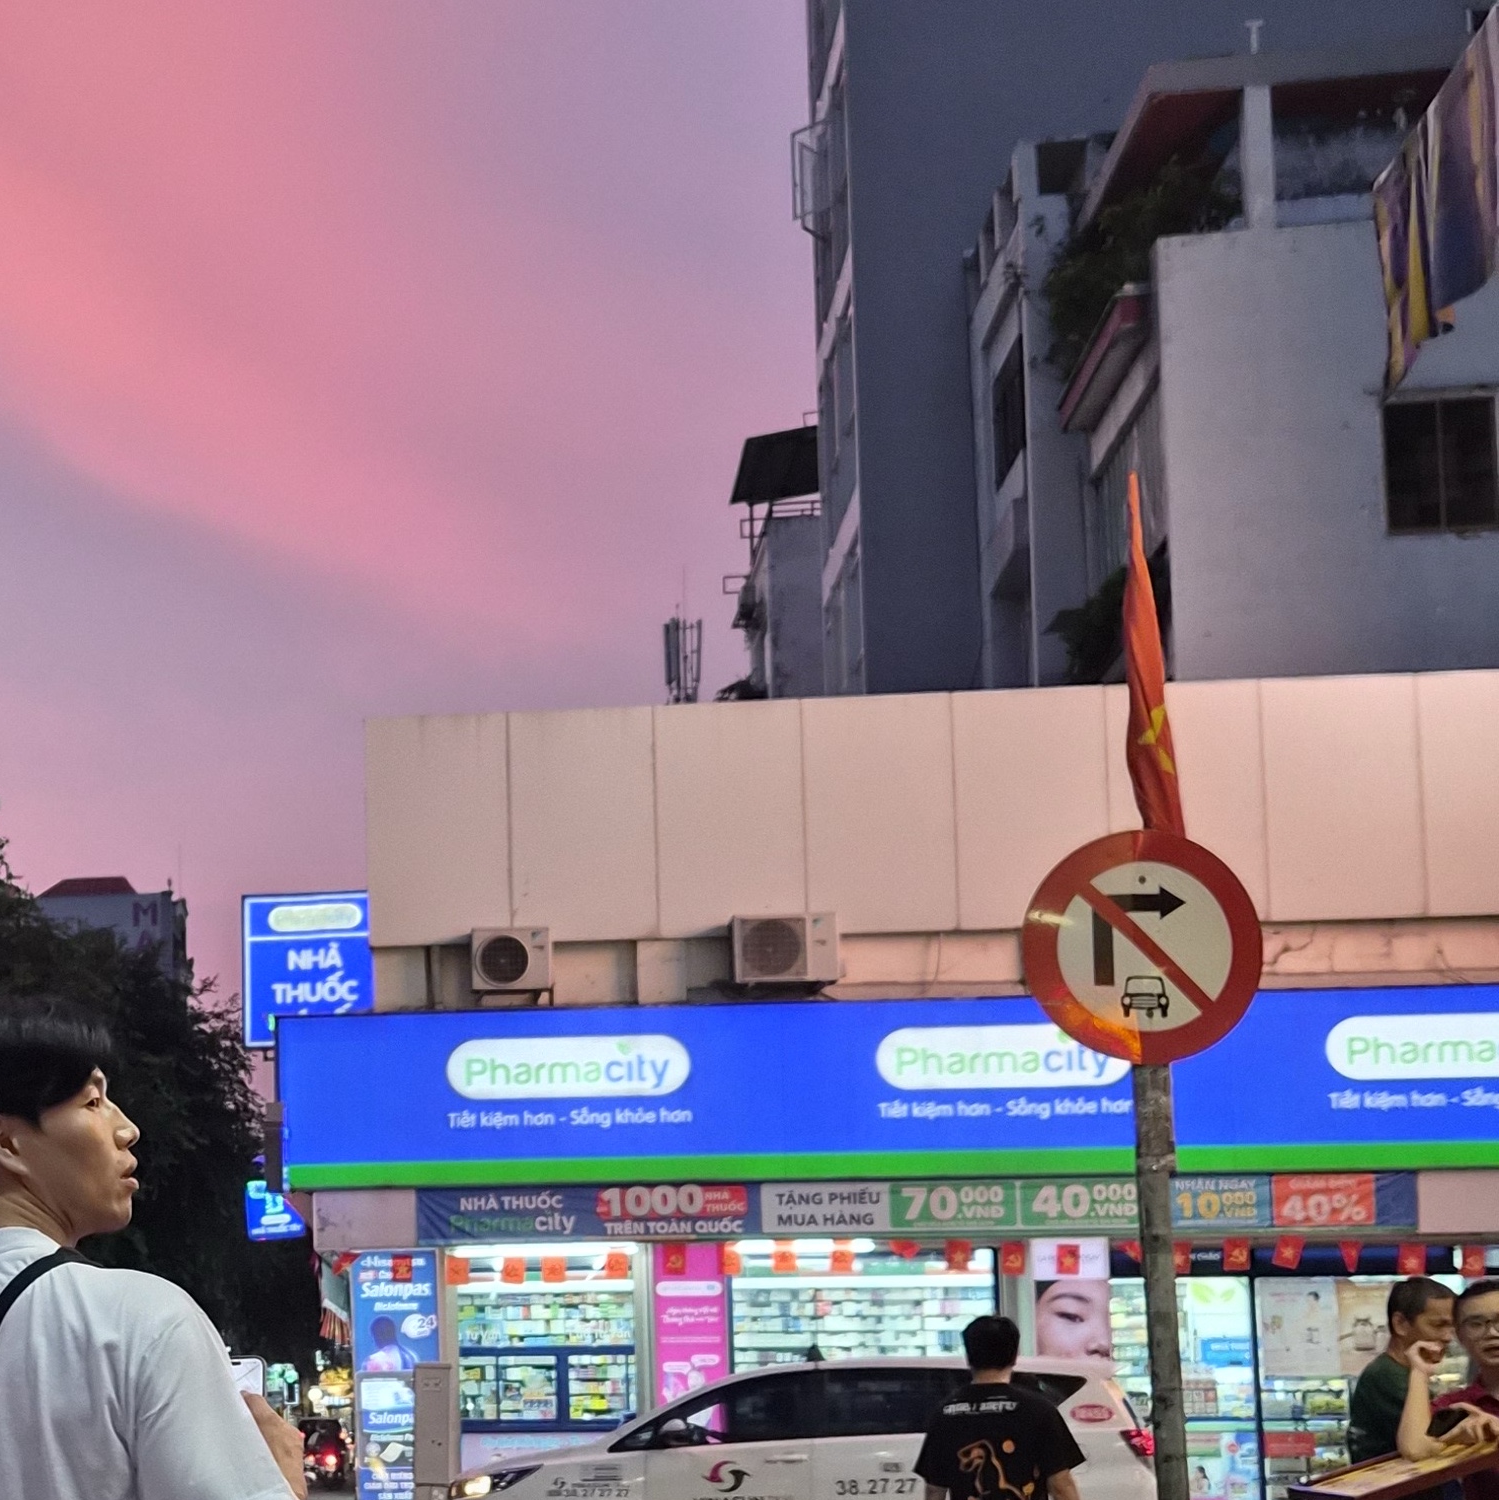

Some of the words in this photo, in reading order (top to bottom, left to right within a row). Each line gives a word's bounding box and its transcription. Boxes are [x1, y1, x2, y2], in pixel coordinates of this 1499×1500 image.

[271, 970, 359, 1004] THUỐC
[1347, 1036, 1498, 1065] Pharma
[463, 1041, 670, 1090] Pharmacity
[460, 1192, 499, 1211] NHÀ
[501, 1190, 564, 1210] THUỐC
[599, 1184, 704, 1217] 1000
[828, 1186, 880, 1204] PHIẾU
[901, 1186, 958, 1220] 70
[1032, 1184, 1091, 1218] 40
[1175, 1192, 1220, 1219] 10
[1283, 1193, 1367, 1222] 40%
[604, 1221, 645, 1234] TRÊN
[647, 1218, 692, 1234] TOÀN
[695, 1216, 744, 1234] QUỐC
[777, 1213, 818, 1226] MUA
[822, 1210, 875, 1226] HÀNG
[360, 1281, 431, 1300] Salonpas
[417, 1313, 435, 1329] 24
